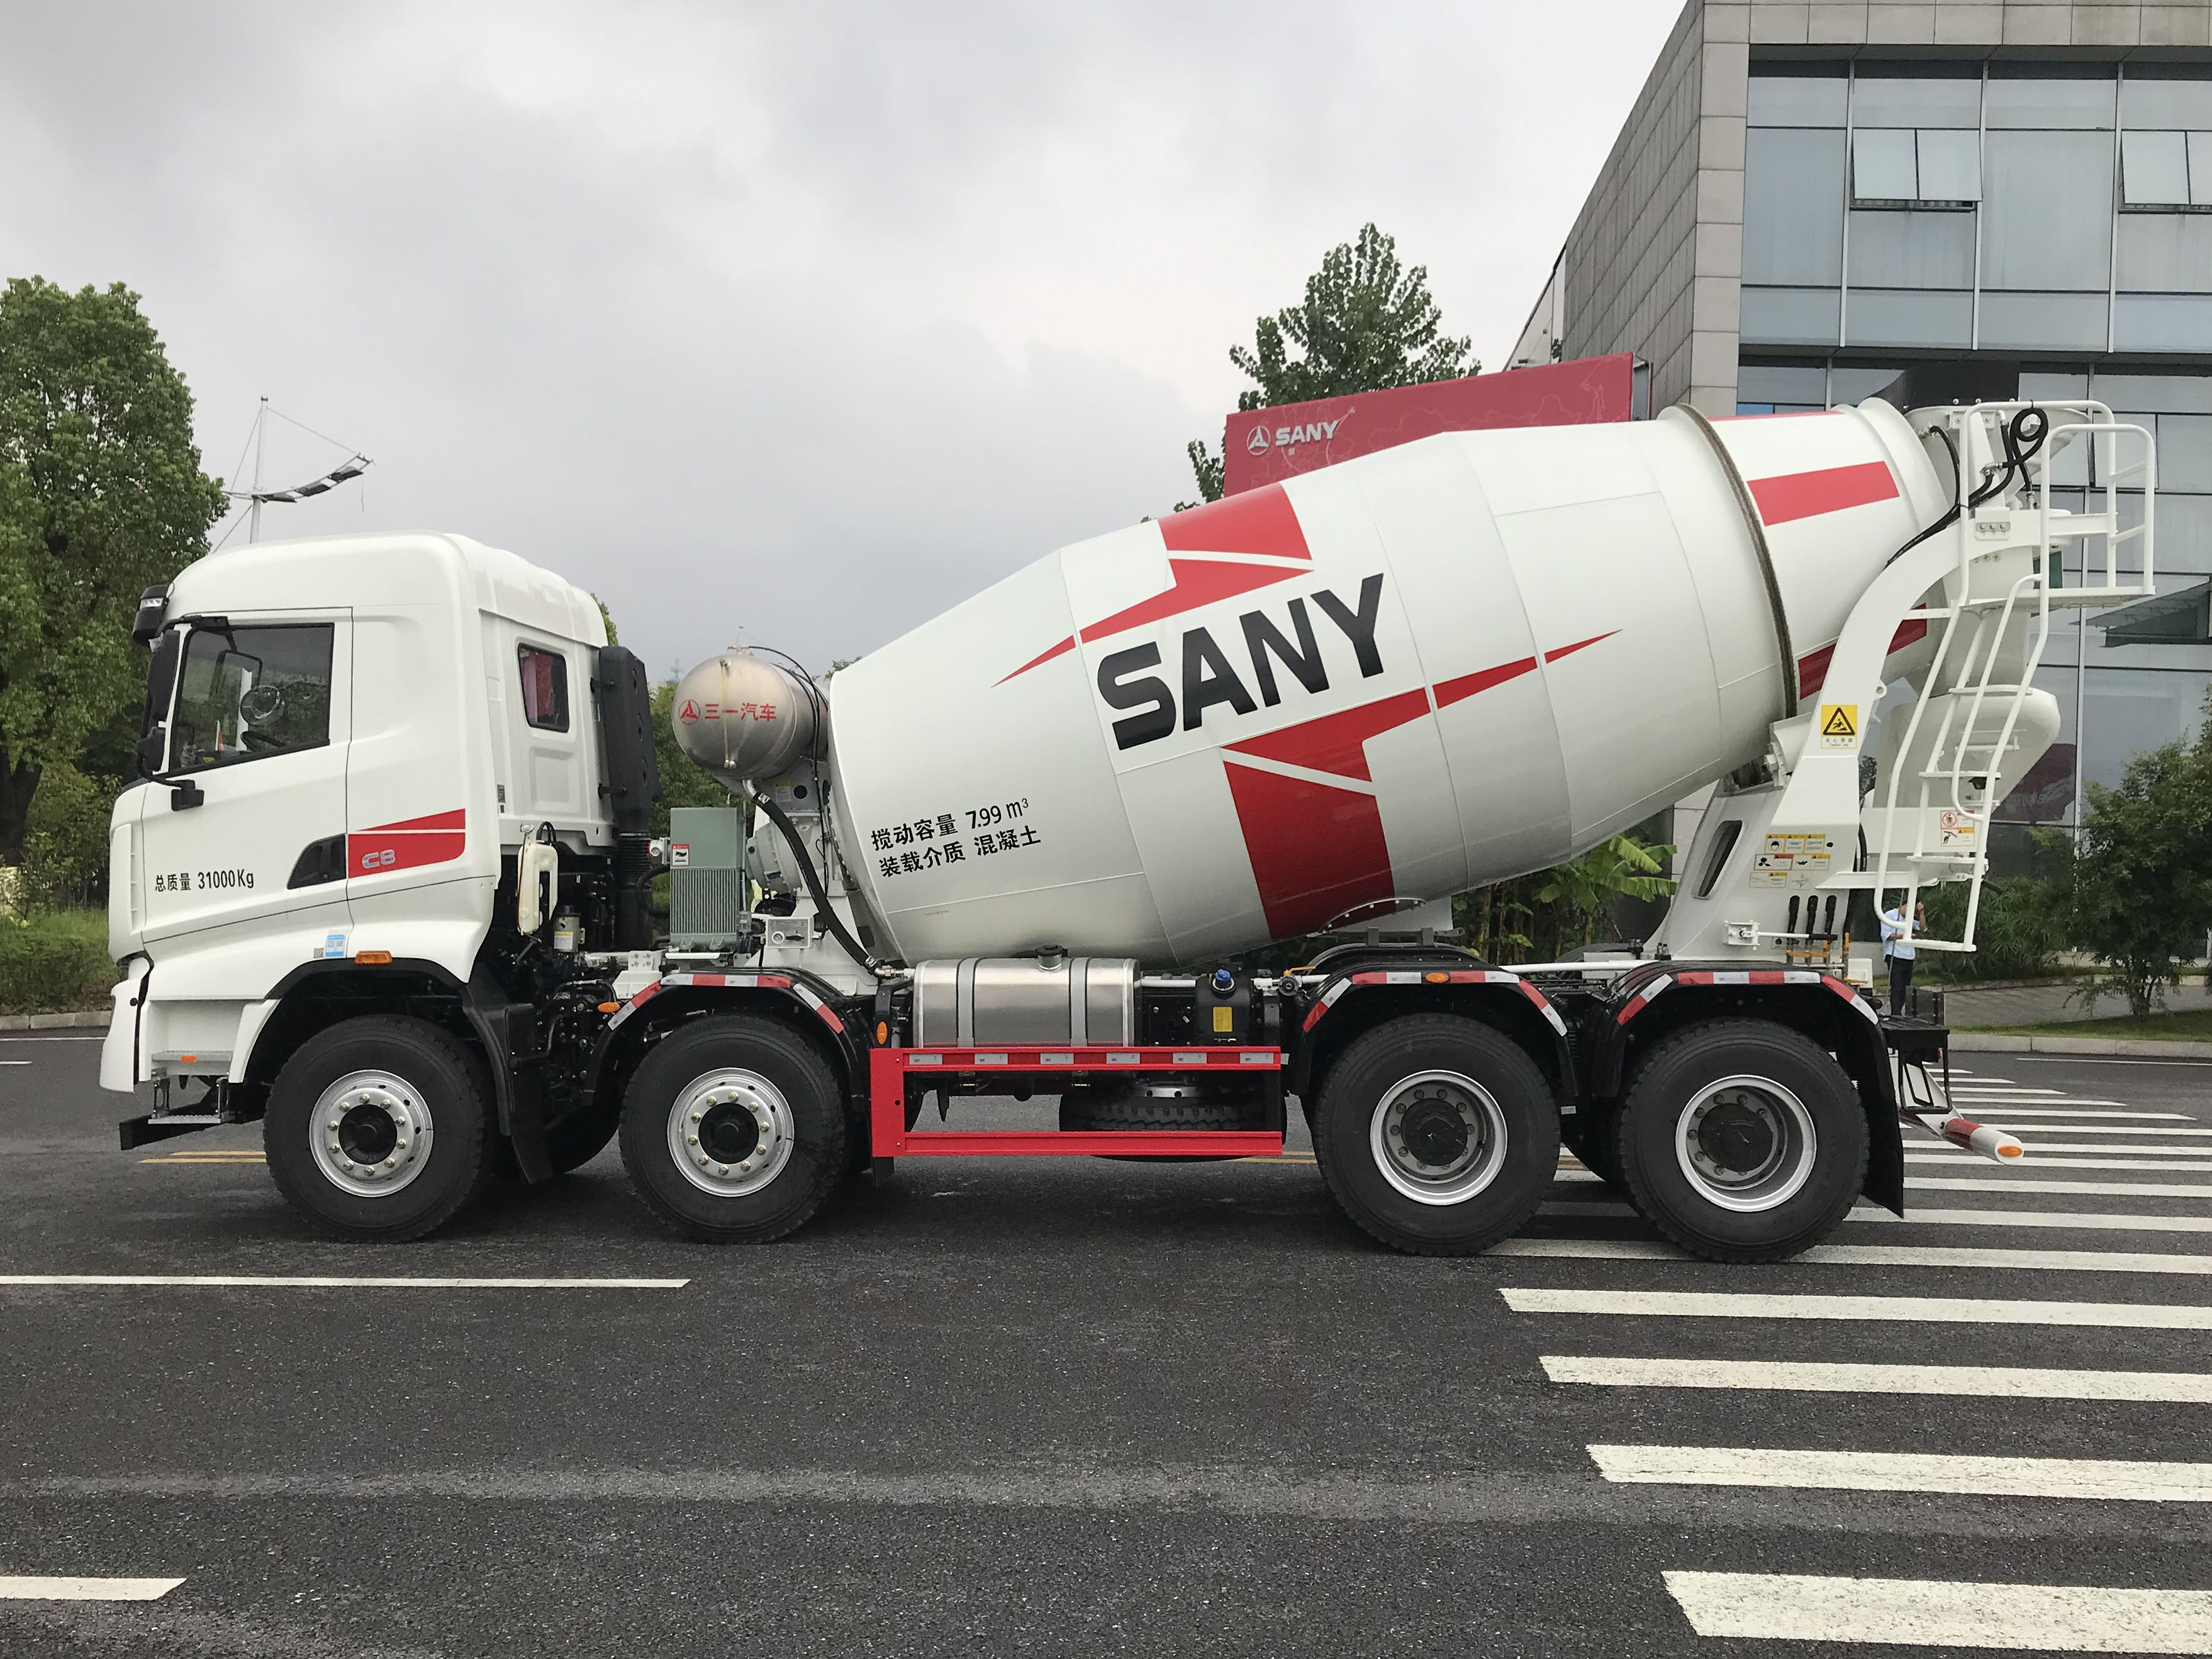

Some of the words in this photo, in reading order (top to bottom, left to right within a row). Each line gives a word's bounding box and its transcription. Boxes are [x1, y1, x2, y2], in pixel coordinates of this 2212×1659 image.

[1275, 420, 1339, 446] SANY
[1097, 573, 1384, 751] SANY
[705, 703, 777, 722] 三一汽车
[871, 813, 958, 851] 搅动容量
[965, 805, 1002, 829] 7.99
[362, 849, 396, 869] C8
[879, 841, 966, 878] 装载介质
[974, 825, 1041, 856] 混凝土
[155, 873, 191, 892] 总质量
[198, 869, 254, 889] 31000Kg
